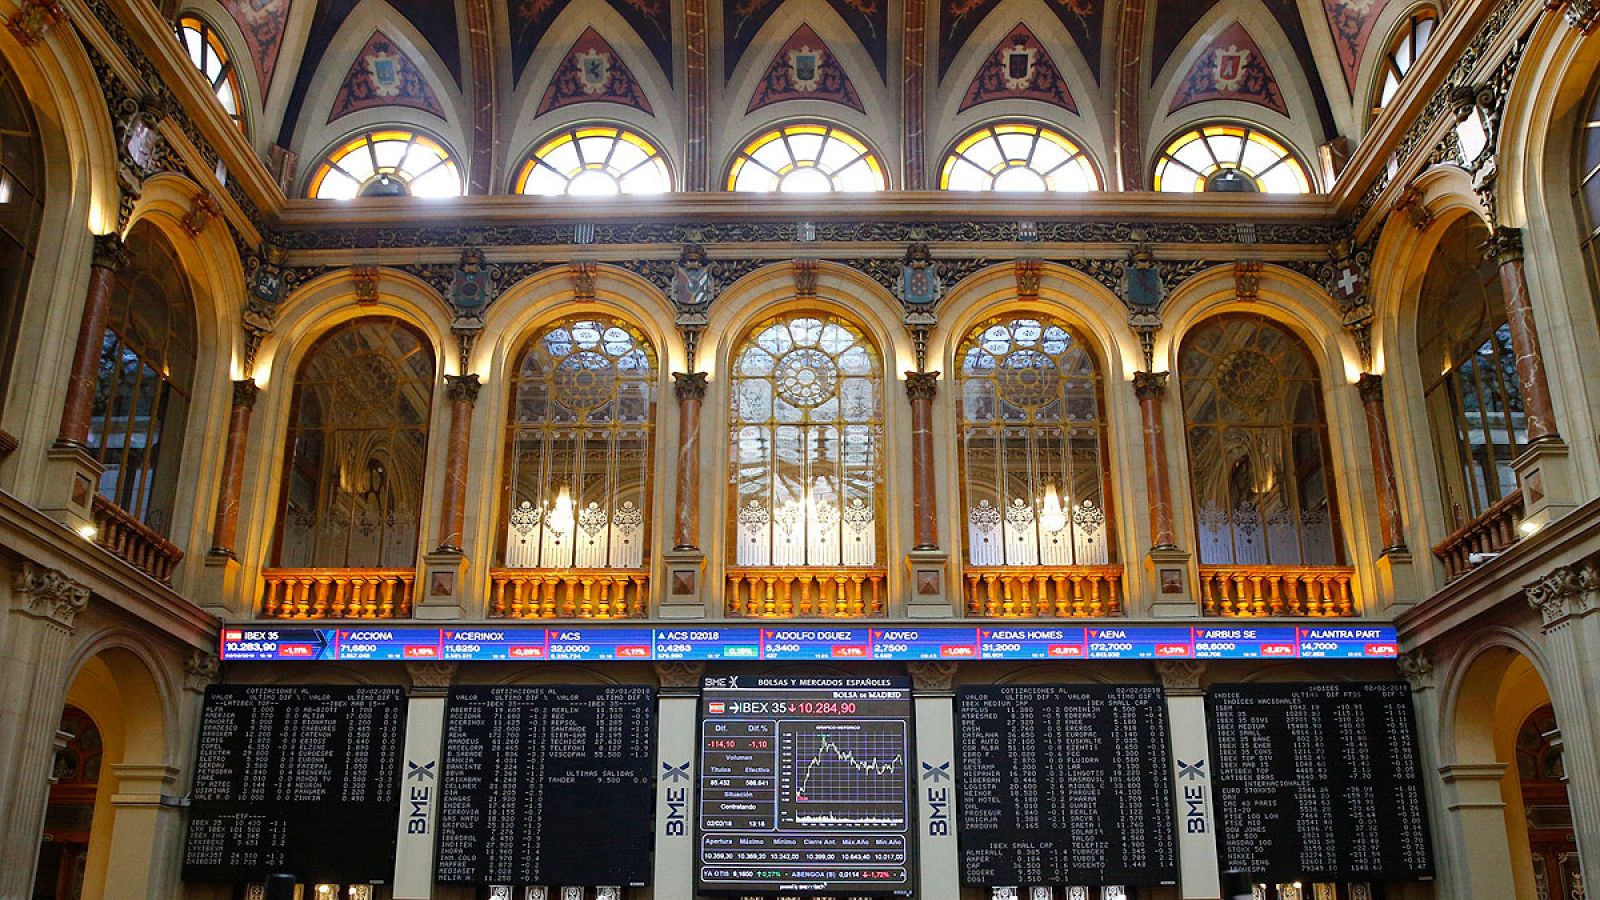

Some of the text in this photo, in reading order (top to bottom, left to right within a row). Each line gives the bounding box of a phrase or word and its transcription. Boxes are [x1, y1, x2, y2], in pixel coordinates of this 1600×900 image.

[244, 632, 279, 641] IBEX 35
[350, 632, 393, 640] ACCIONA
[454, 632, 504, 640] ACERINOX
[560, 632, 581, 641] ACS
[667, 632, 720, 641] ACS D2018
[775, 632, 852, 640] ADOLFO DGUEZ
[883, 632, 918, 640] ADVEO
[991, 631, 1063, 640] AEDAS HOMES
[1099, 631, 1126, 639] AENA
[1205, 631, 1257, 639] AIRBUS SE
[1310, 630, 1381, 639] ALANTRA PART
[550, 645, 590, 653] 32,0000
[982, 644, 1021, 652] 31,2000
[1089, 644, 1132, 652] 172,7000
[705, 678, 726, 686] BME
[846, 678, 891, 686] ESPAÑOLES
[739, 702, 787, 713] IBEX 35
[799, 702, 856, 715] 10.284,90
[708, 740, 735, 748] -114,10
[749, 740, 768, 748] -1,10
[408, 786, 428, 834] BME
[666, 787, 684, 836] BME
[929, 787, 947, 836] BME
[1185, 786, 1205, 833] BME
